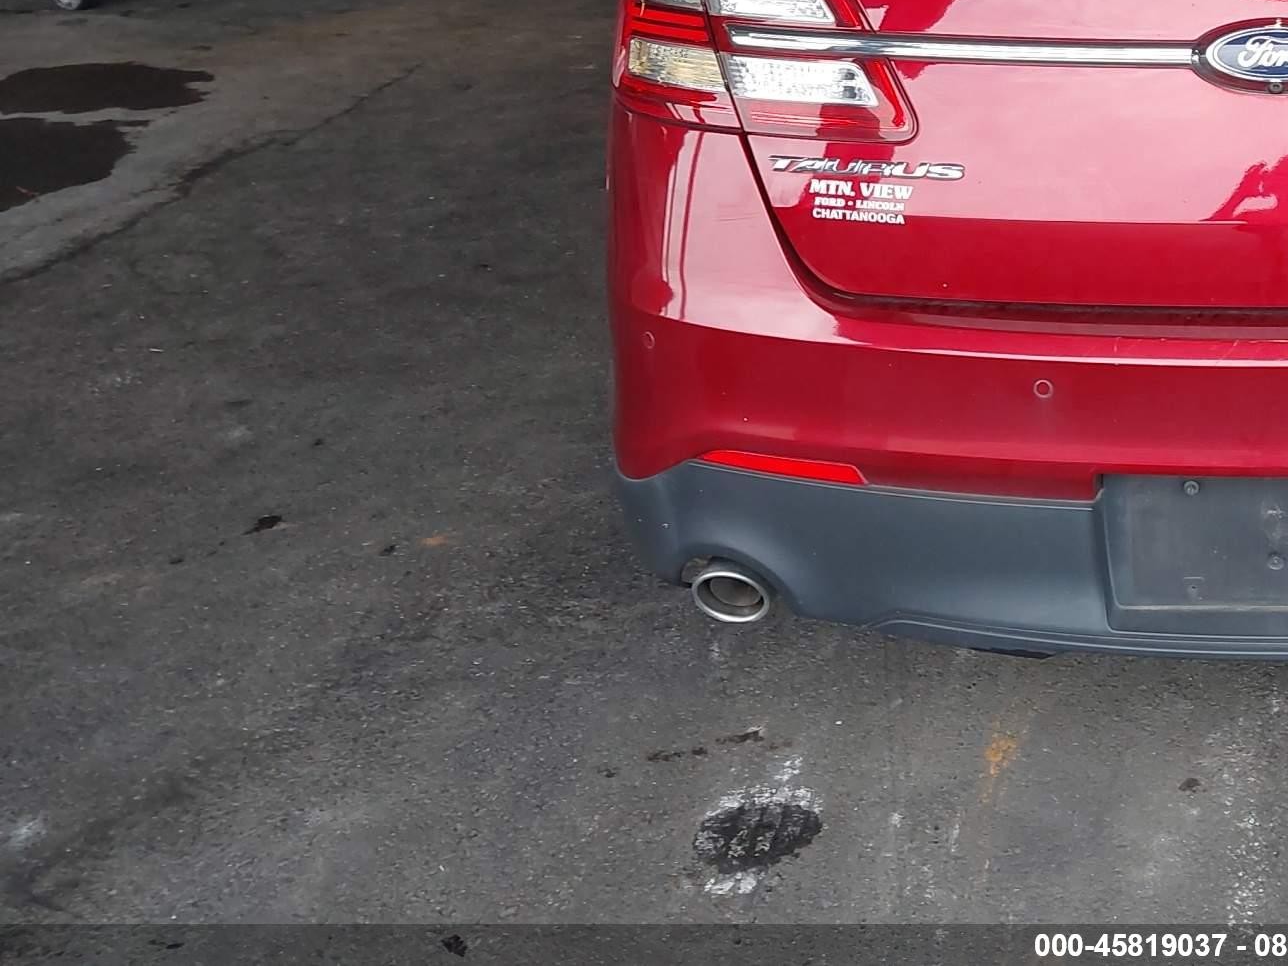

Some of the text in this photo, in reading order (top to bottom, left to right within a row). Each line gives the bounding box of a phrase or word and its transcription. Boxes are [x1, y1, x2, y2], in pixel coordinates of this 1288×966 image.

[769, 155, 965, 179] TAURUS
[809, 178, 914, 200] MTN. VIEW
[814, 196, 905, 211] FORD LINCOLN
[812, 207, 905, 225] CHATTANOOGA
